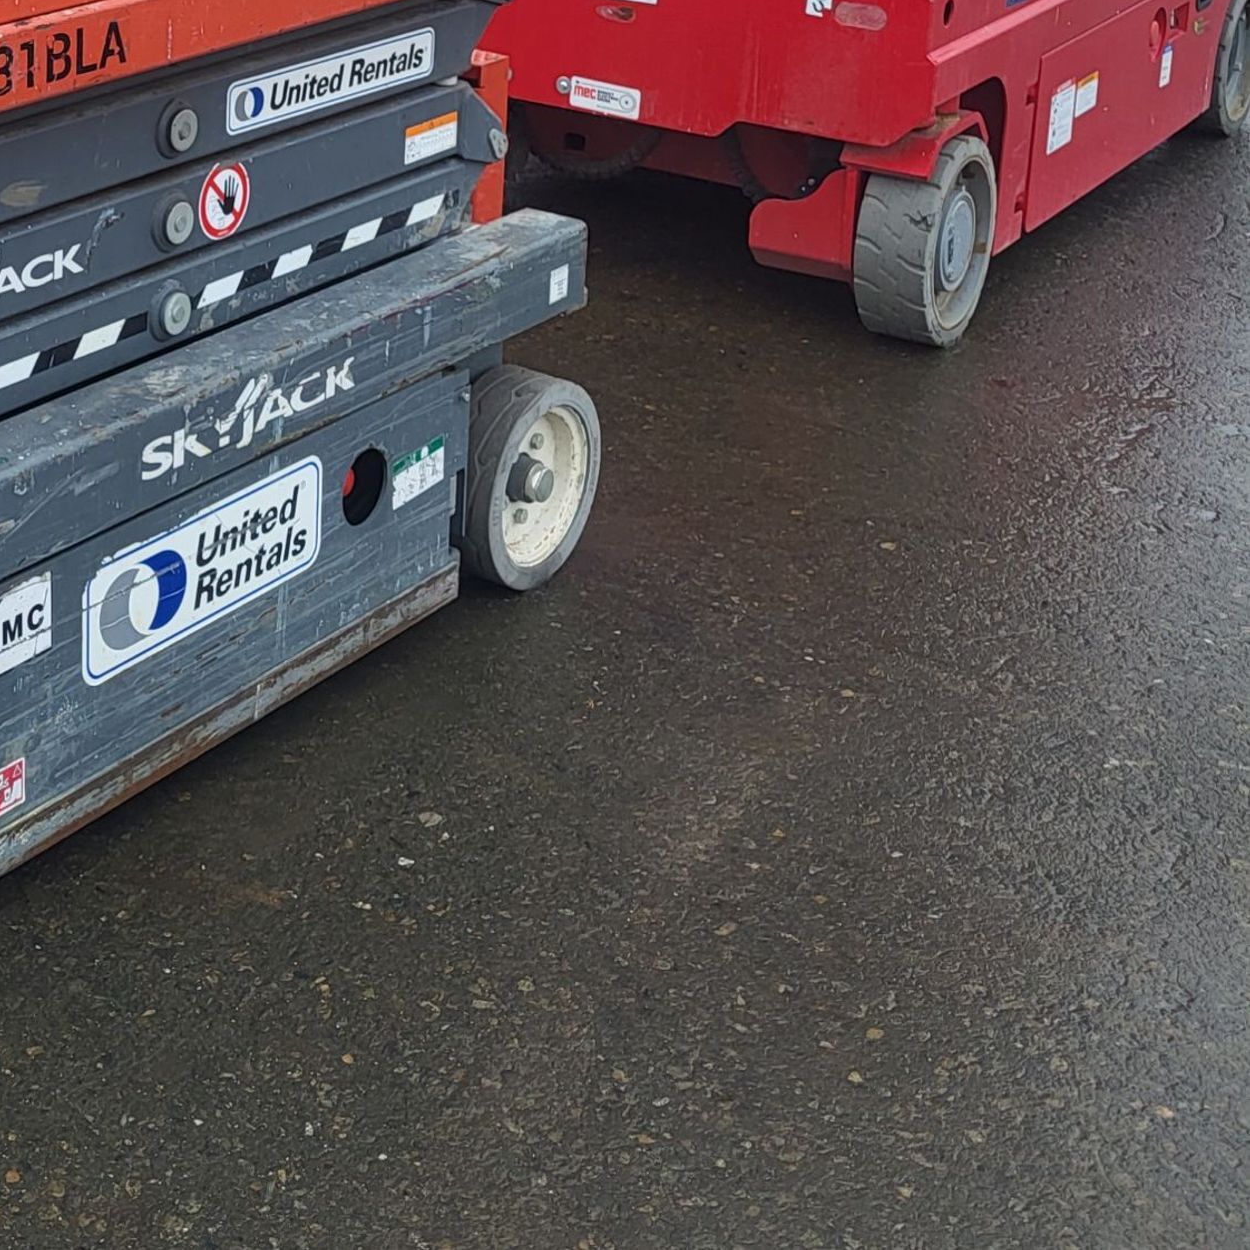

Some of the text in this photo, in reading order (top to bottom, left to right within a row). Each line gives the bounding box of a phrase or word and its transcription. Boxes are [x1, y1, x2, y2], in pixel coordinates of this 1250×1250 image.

[269, 43, 424, 110] United Rentals
[141, 356, 355, 481] SKYJACK
[195, 480, 300, 568] United
[194, 526, 307, 611] Rentals
